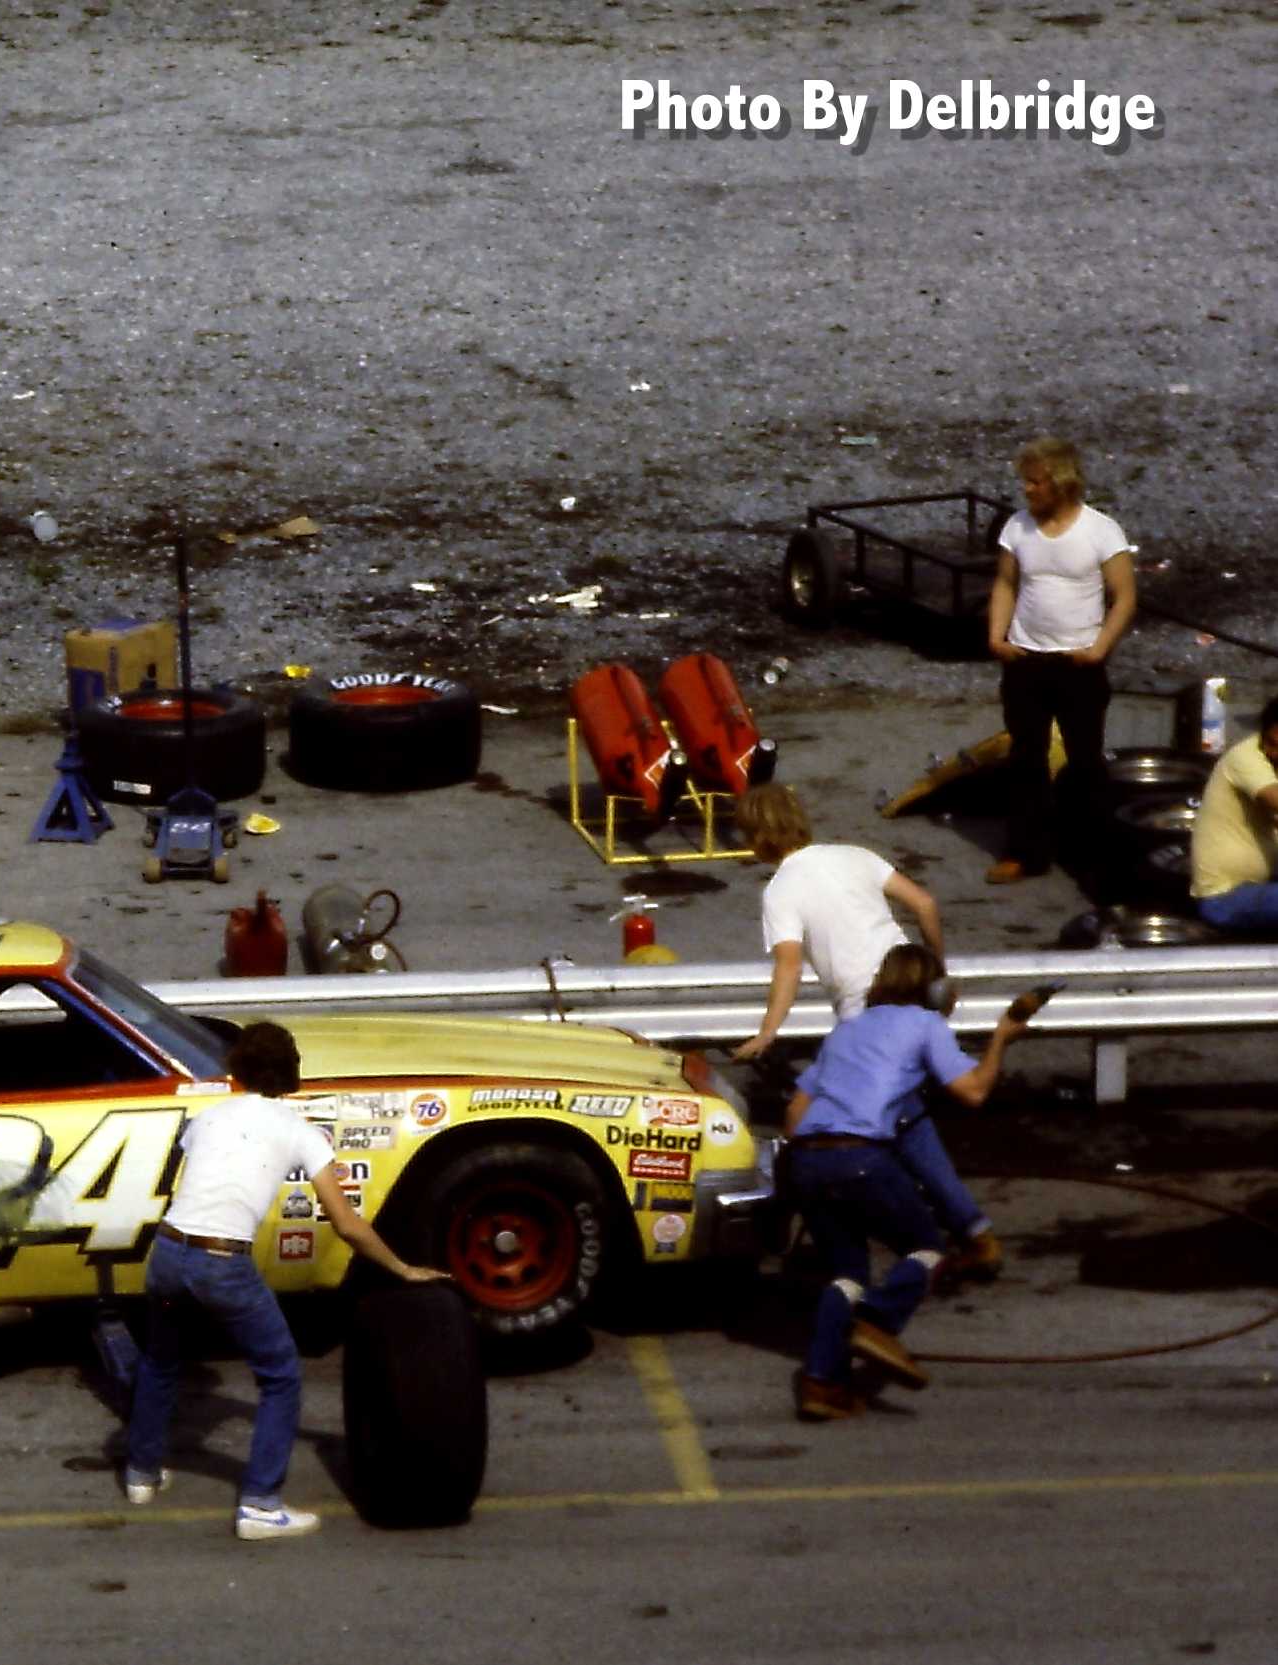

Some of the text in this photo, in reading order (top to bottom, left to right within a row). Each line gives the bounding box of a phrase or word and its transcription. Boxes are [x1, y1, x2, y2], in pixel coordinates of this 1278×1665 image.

[416, 1101, 440, 1118] 76
[342, 1125, 392, 1138] SPEED
[606, 1125, 703, 1151] DieHard
[339, 1138, 371, 1149] PRO
